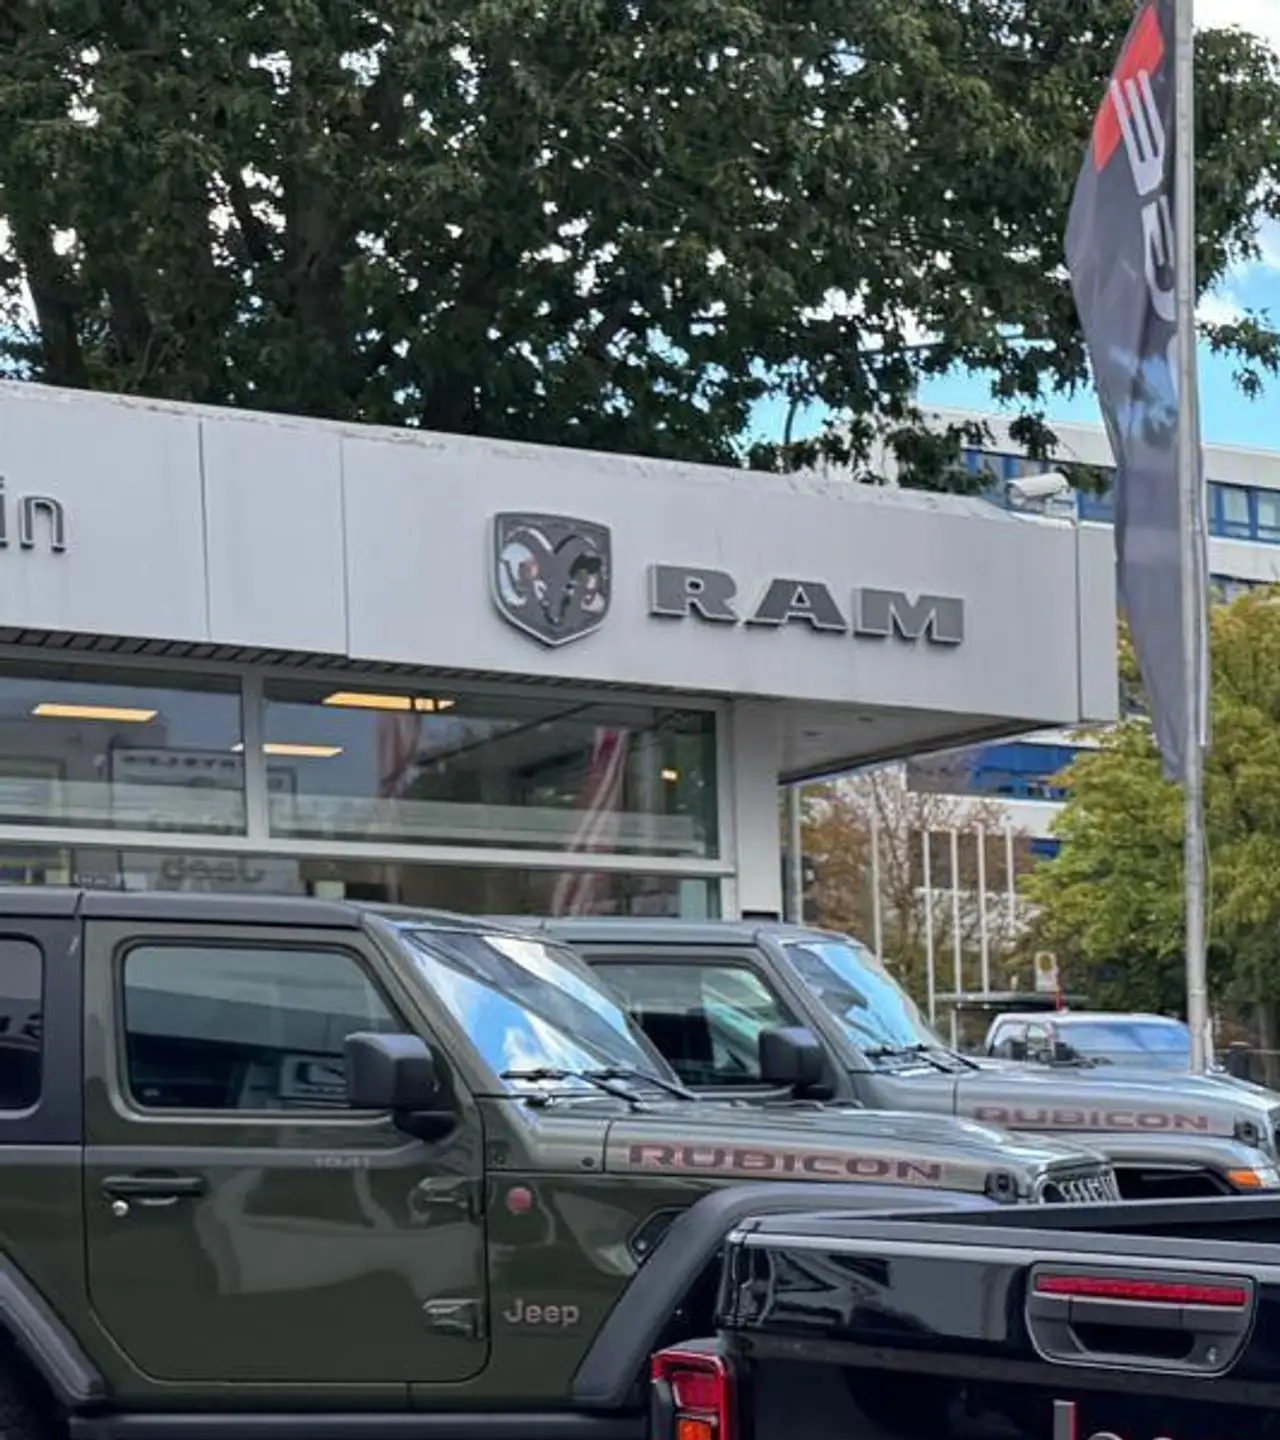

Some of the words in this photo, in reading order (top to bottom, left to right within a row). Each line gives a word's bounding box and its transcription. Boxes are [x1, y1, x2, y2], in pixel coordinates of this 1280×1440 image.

[646, 562, 966, 646] RAM
[974, 1105, 1209, 1131] RUBICON
[628, 1143, 943, 1181] RUBICON
[501, 1298, 580, 1329] Jeep
